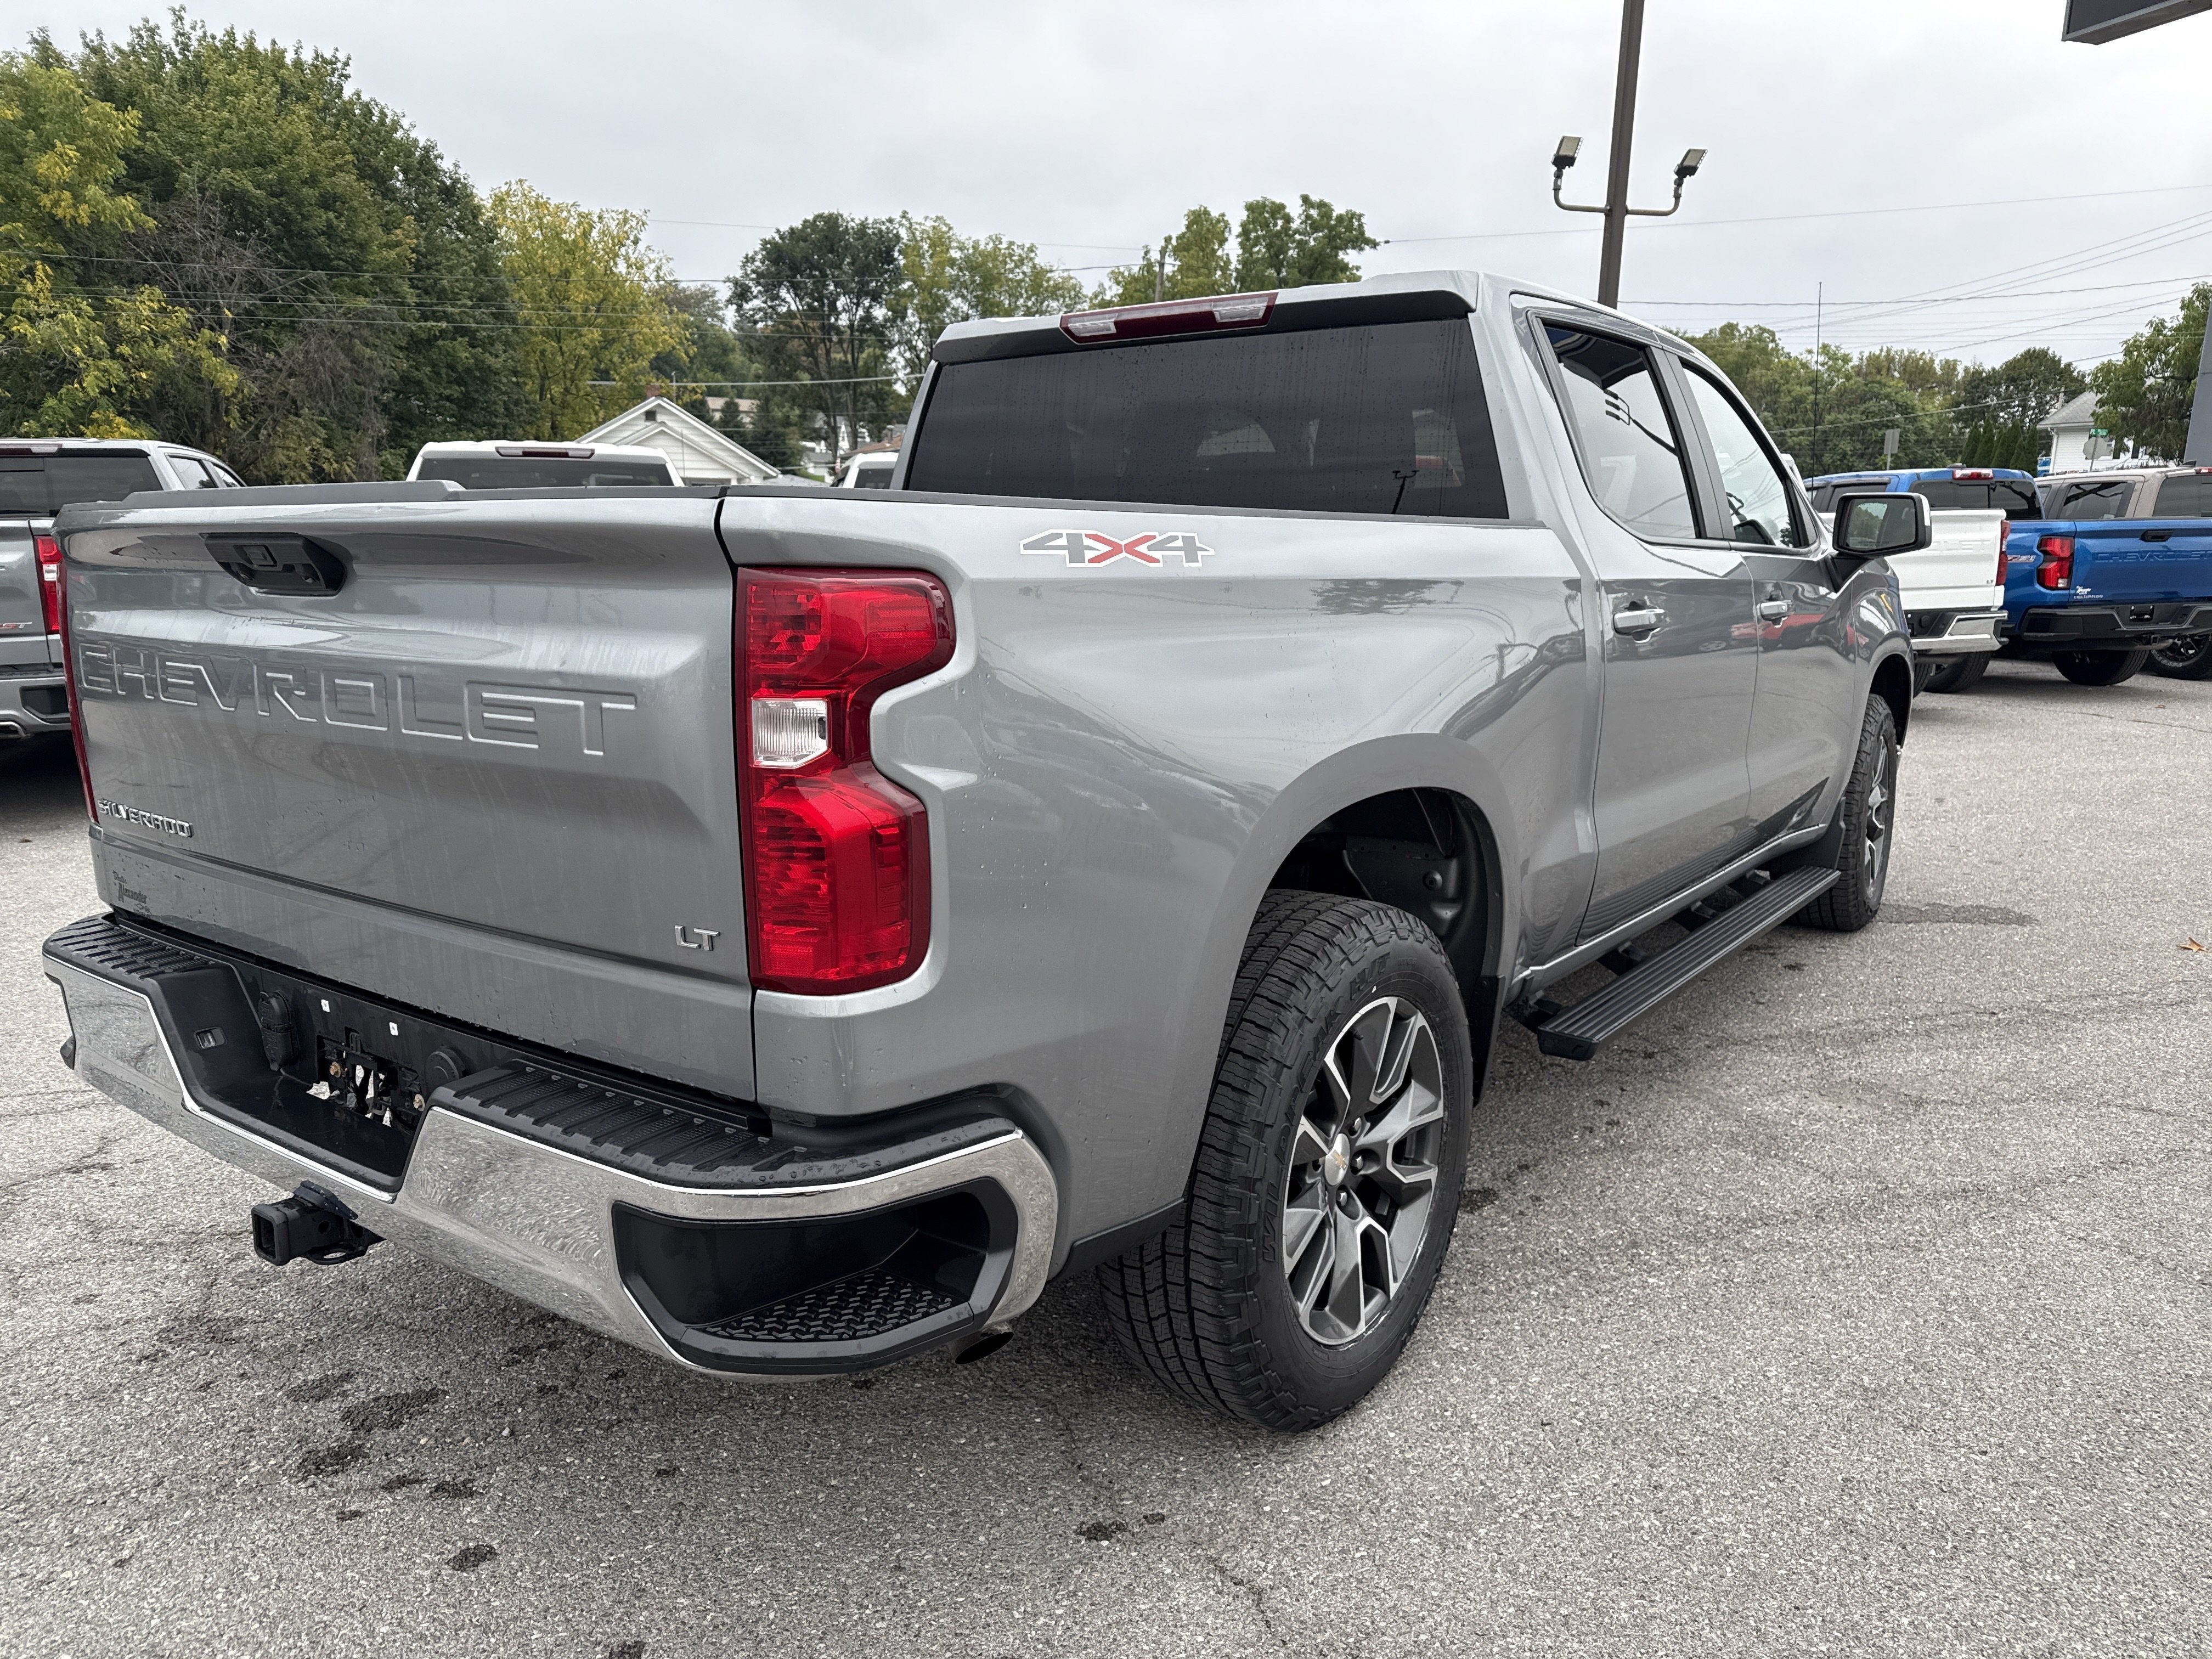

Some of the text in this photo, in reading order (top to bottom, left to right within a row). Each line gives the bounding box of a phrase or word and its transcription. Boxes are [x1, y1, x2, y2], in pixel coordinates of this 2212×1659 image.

[79, 642, 637, 756] CHEVROLET
[98, 799, 194, 838] SILVERADO
[675, 924, 721, 951] LT
